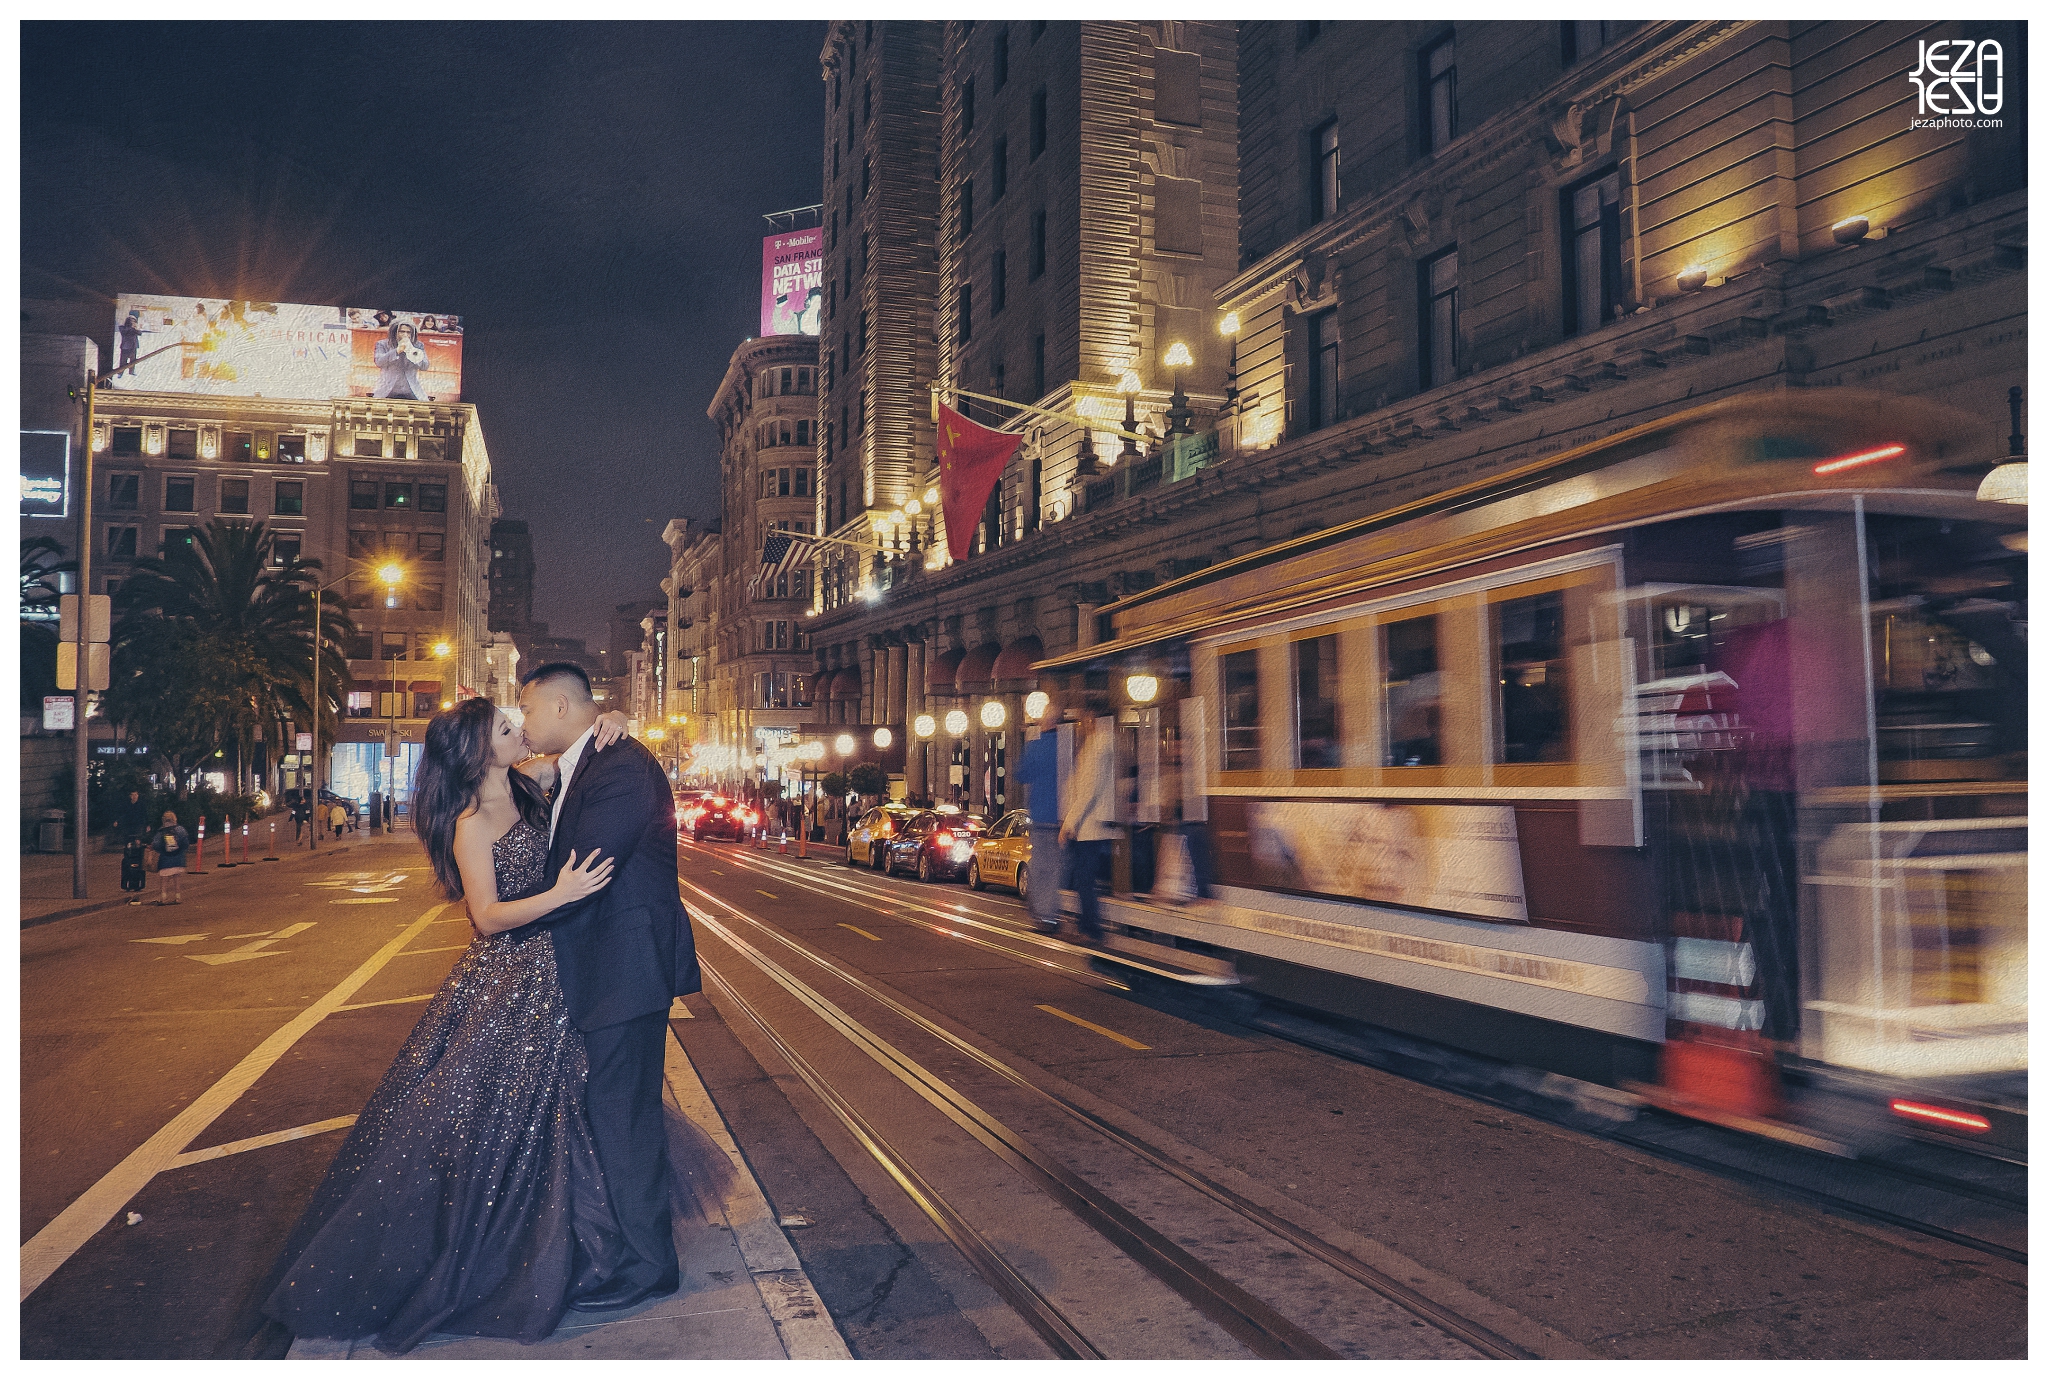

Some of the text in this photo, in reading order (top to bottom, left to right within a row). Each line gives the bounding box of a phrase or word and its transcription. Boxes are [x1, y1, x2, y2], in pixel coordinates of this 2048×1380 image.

[775, 254, 791, 264] SAN
[773, 263, 801, 278] DATA
[260, 328, 350, 344] AMERICAN
